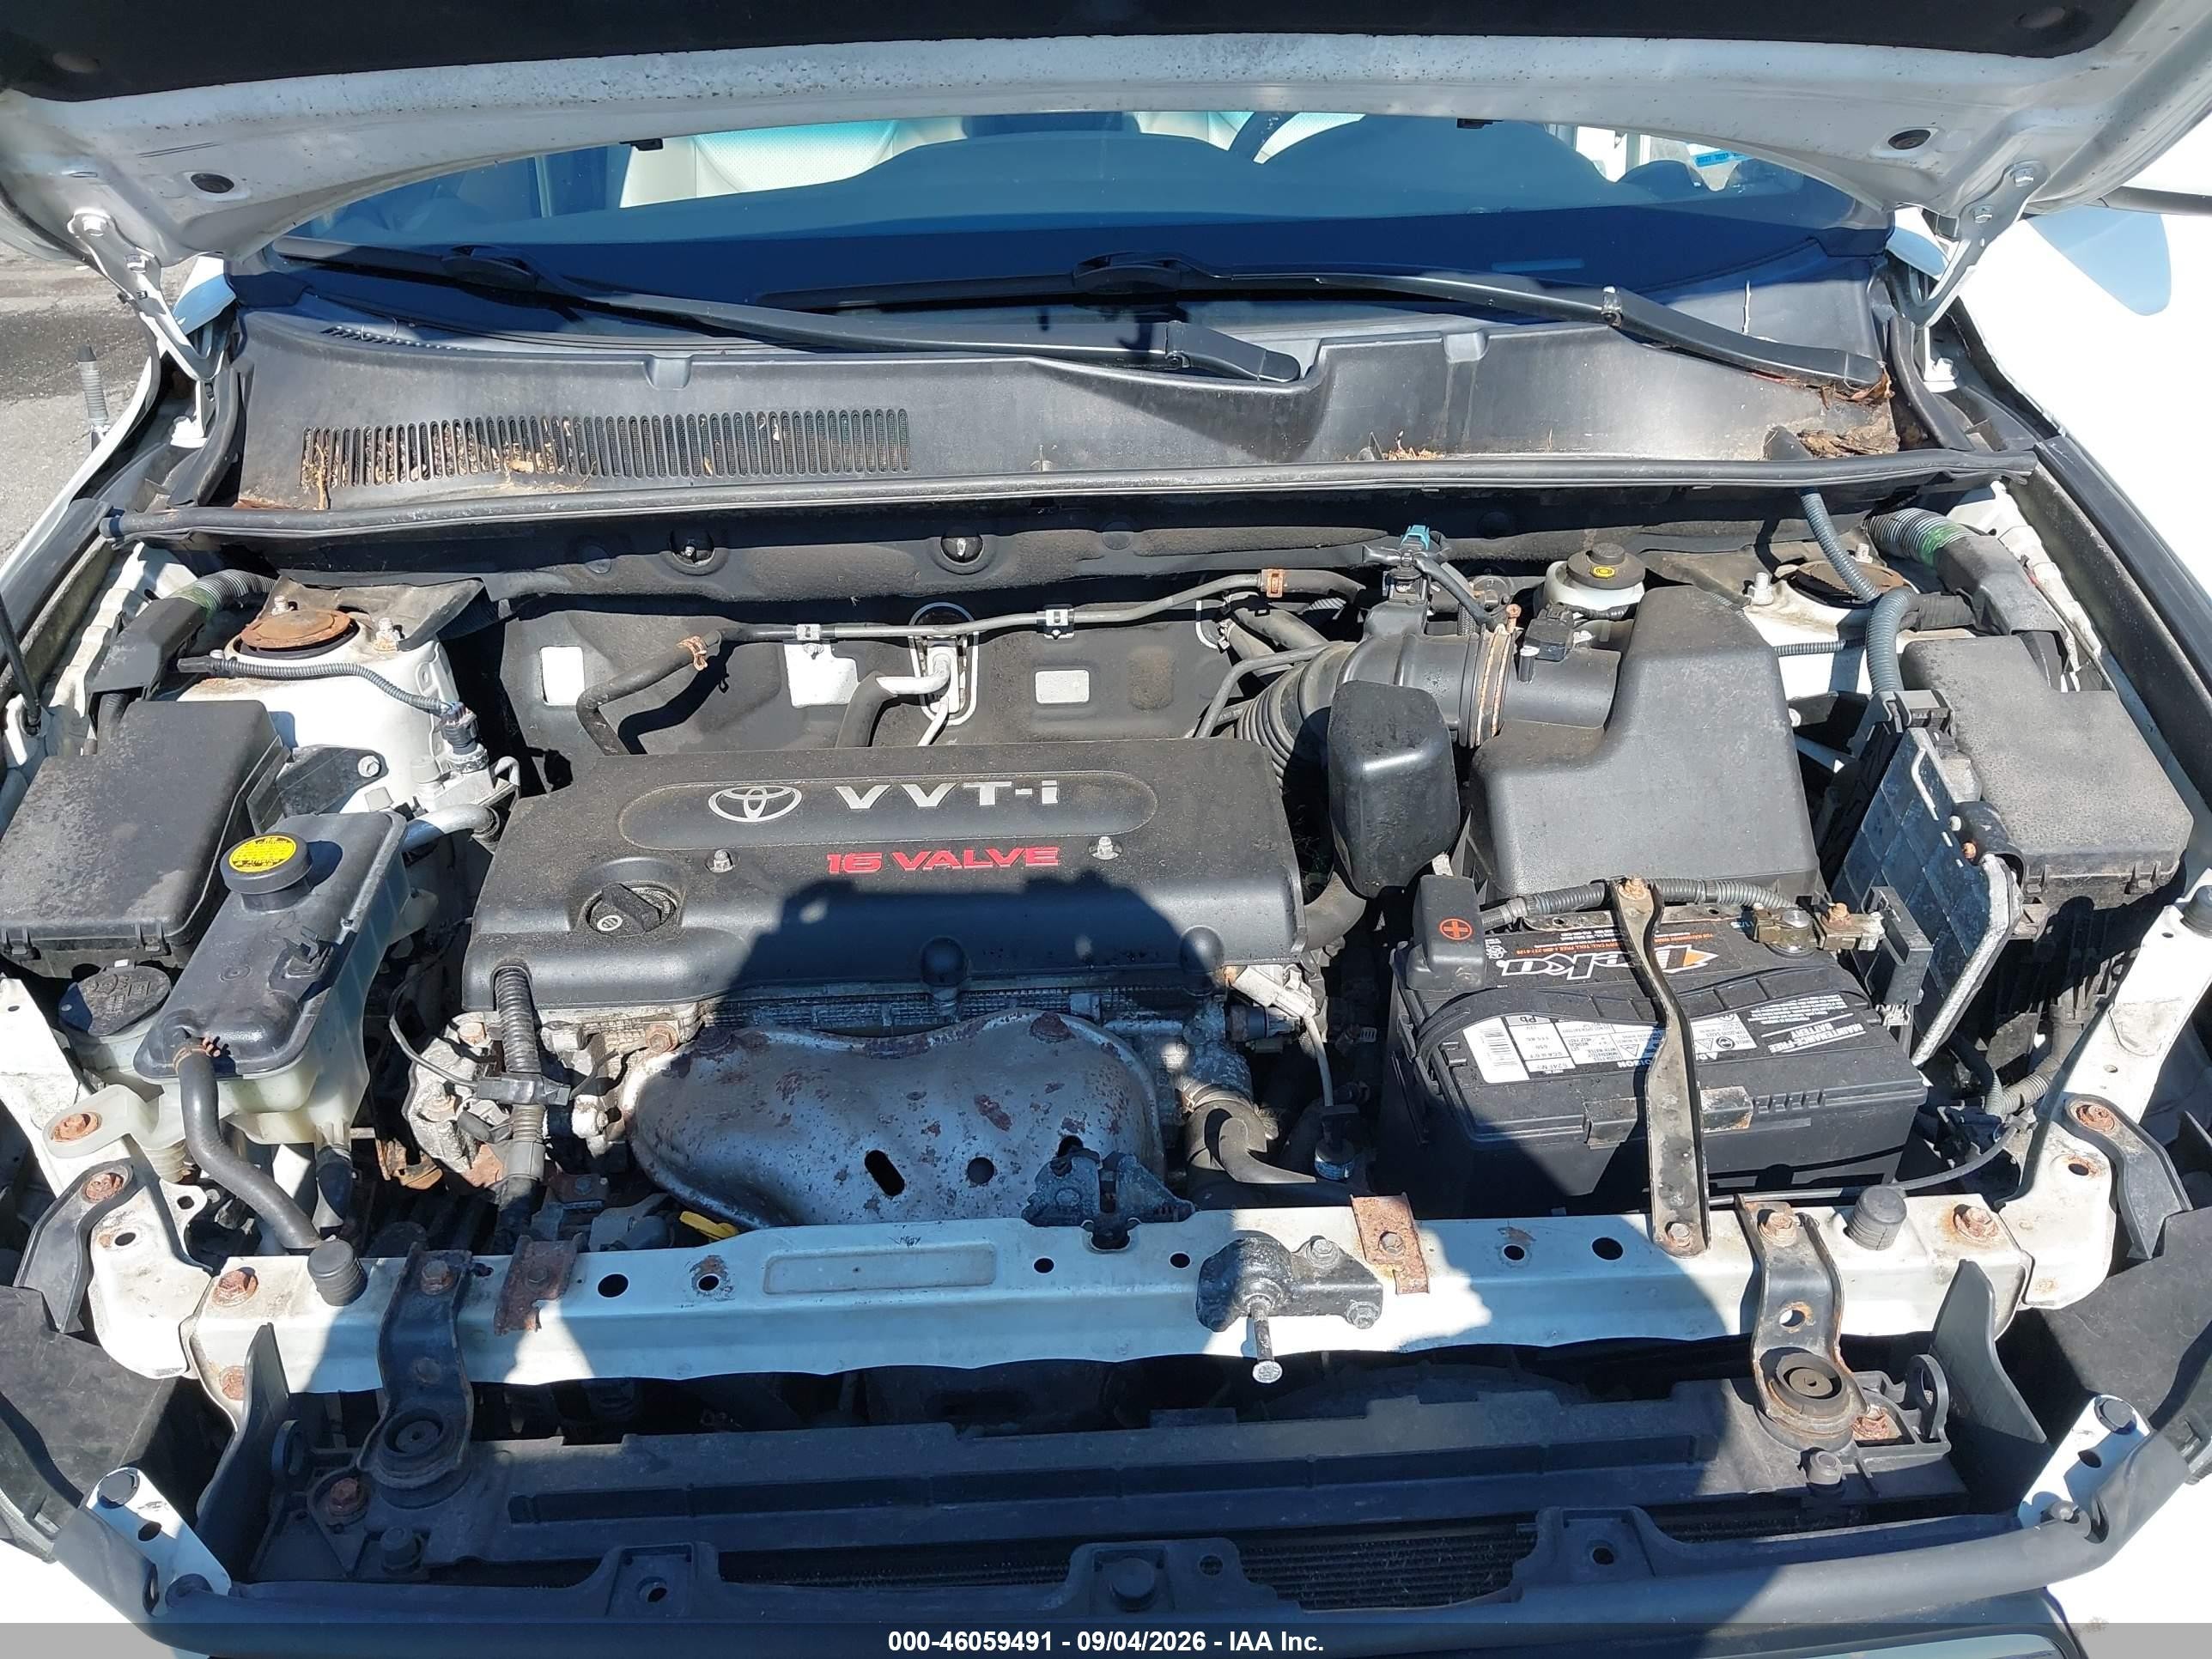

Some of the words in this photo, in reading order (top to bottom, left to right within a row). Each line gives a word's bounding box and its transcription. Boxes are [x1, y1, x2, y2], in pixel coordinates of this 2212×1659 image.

[833, 779, 1059, 810] VVT-i
[827, 852, 883, 874] 16
[891, 846, 1060, 872] VALVE
[1767, 1023, 1864, 1054] MAINTENANCE-FREE
[1790, 1022, 1834, 1039] BATTERY
